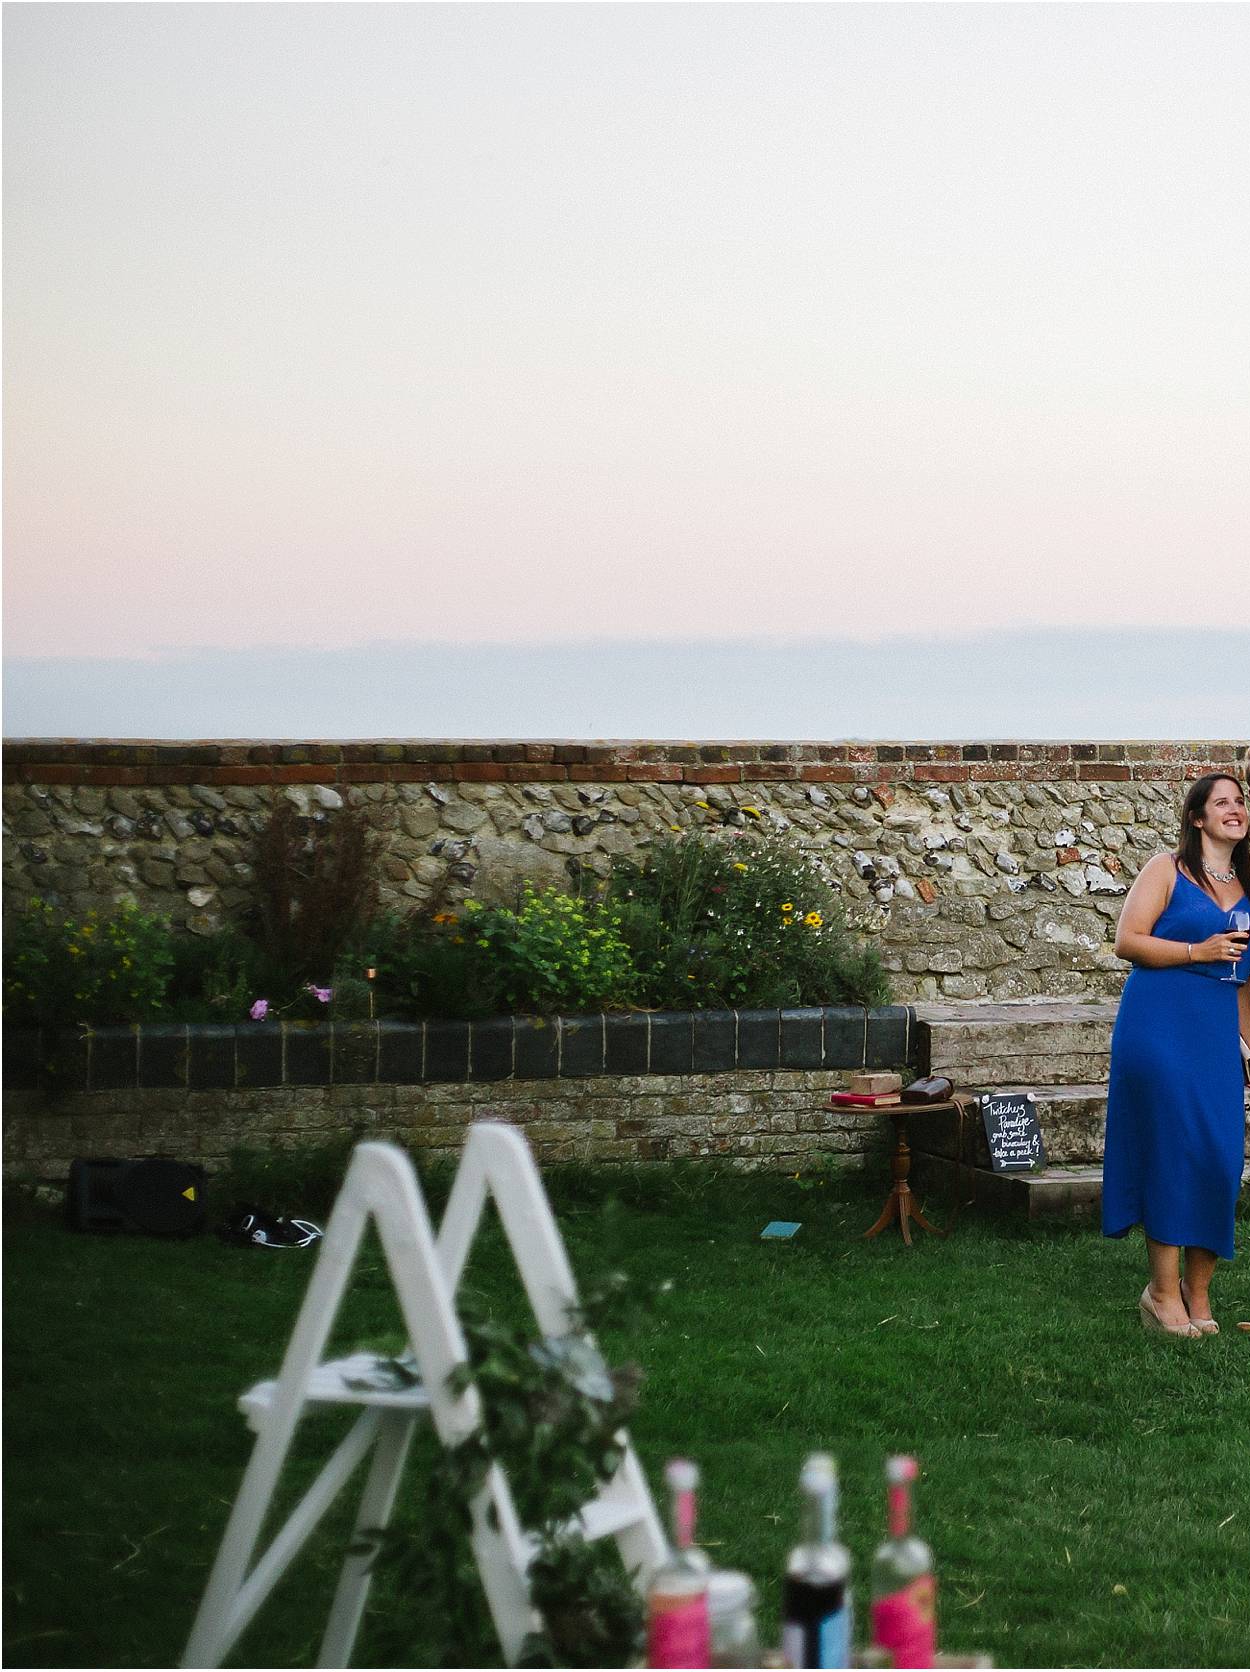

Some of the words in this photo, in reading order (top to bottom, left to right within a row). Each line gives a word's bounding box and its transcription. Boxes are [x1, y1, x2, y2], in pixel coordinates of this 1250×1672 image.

[990, 1130, 1007, 1143] grab
[1007, 1131, 1027, 1140] some
[1032, 1134, 1040, 1146] &
[992, 1147, 1008, 1158] take
